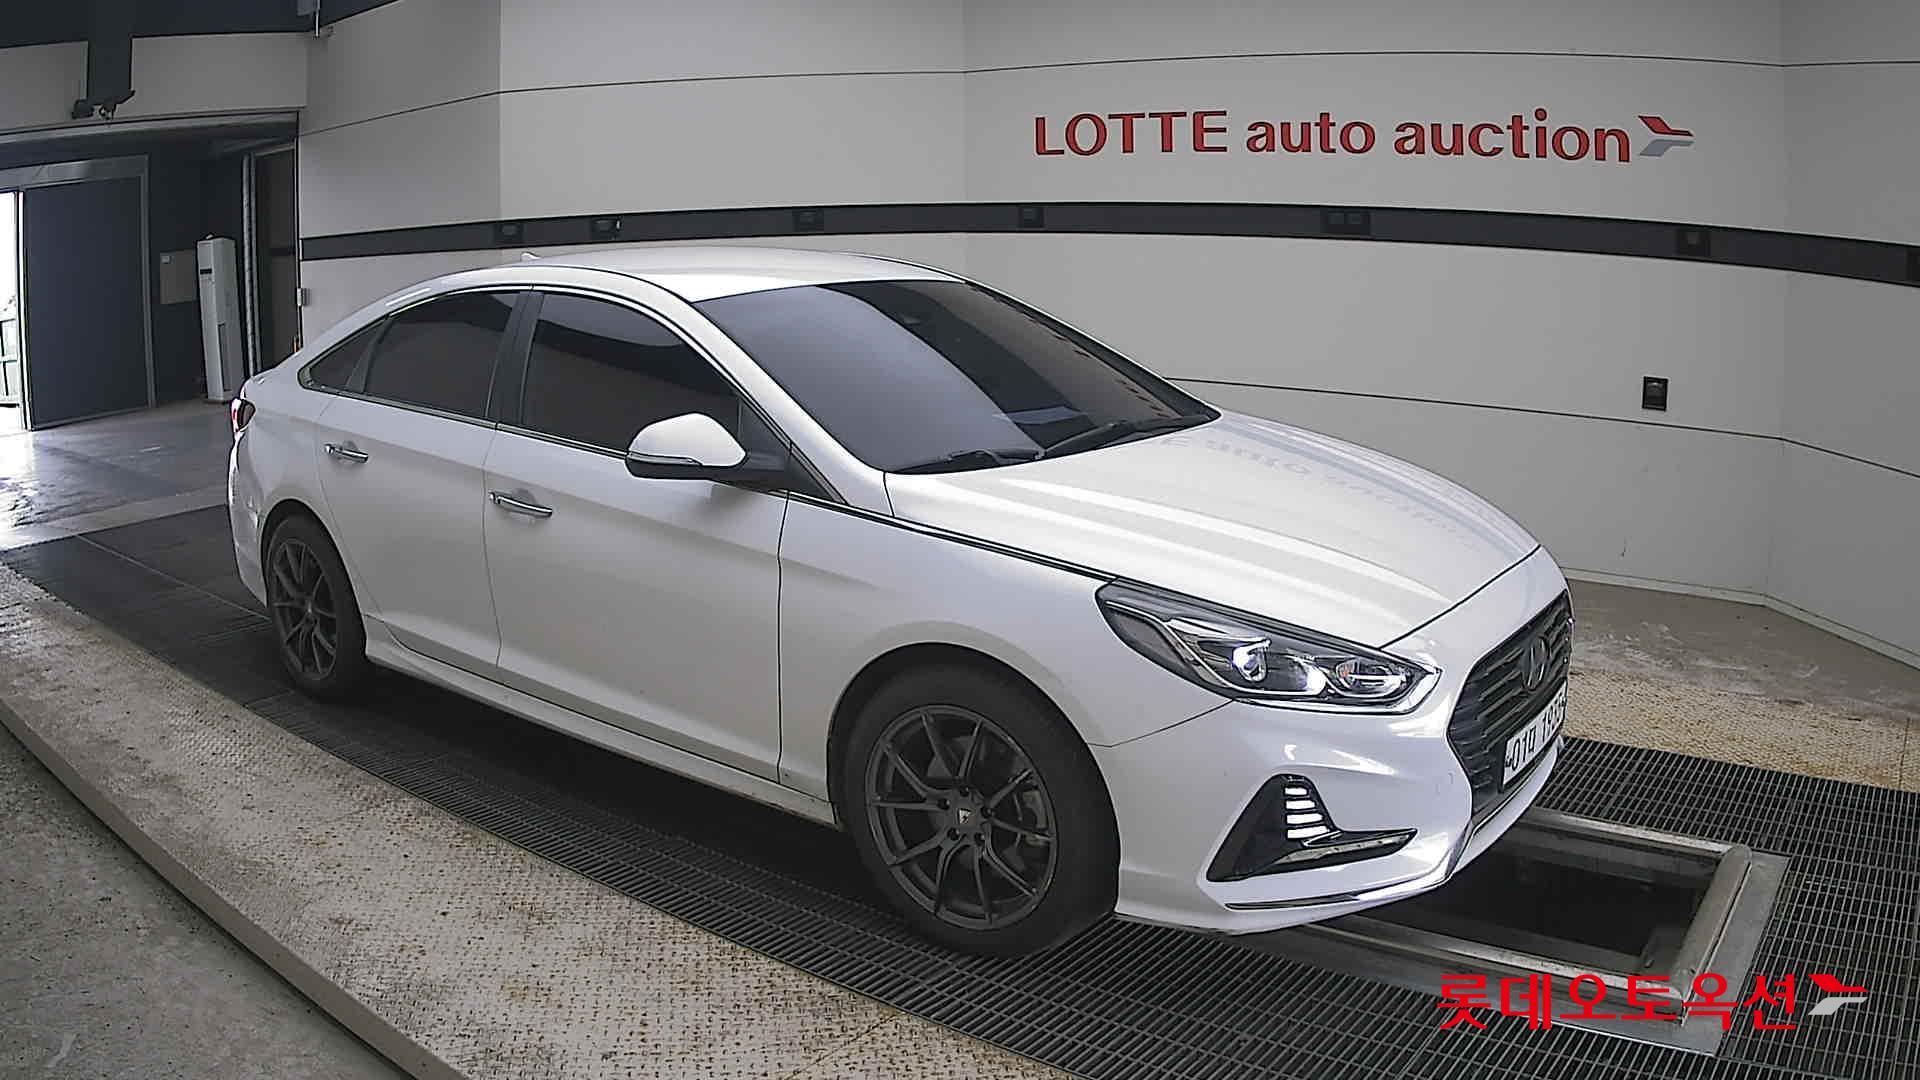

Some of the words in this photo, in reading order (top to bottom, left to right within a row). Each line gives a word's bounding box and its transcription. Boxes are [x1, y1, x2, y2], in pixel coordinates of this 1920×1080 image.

[1035, 110, 1228, 156] LOTTE
[1246, 112, 1376, 155] auto
[1394, 108, 1631, 163] auction
